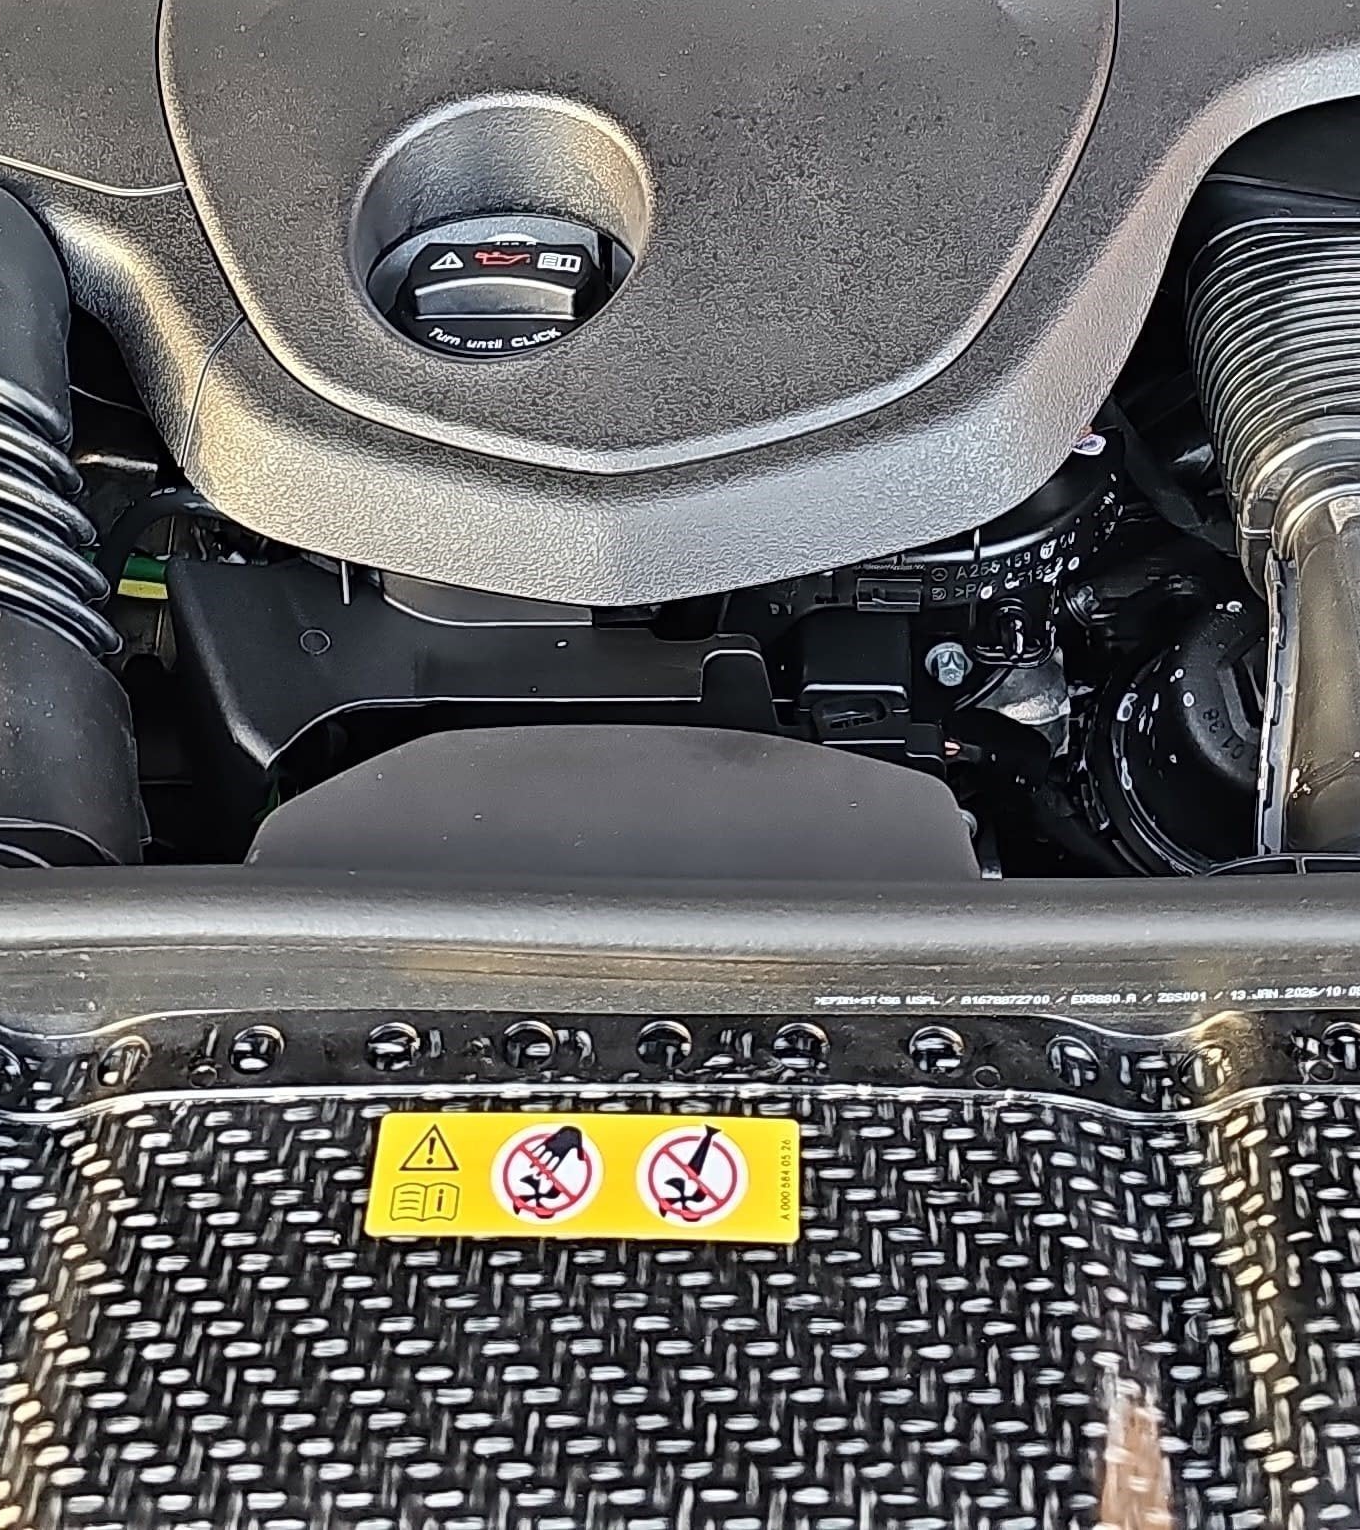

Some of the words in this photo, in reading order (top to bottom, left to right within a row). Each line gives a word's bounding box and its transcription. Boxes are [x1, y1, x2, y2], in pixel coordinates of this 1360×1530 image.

[427, 326, 462, 346] Turn
[465, 338, 503, 349] until
[510, 327, 562, 348] CLICK
[780, 1213, 791, 1222] A
